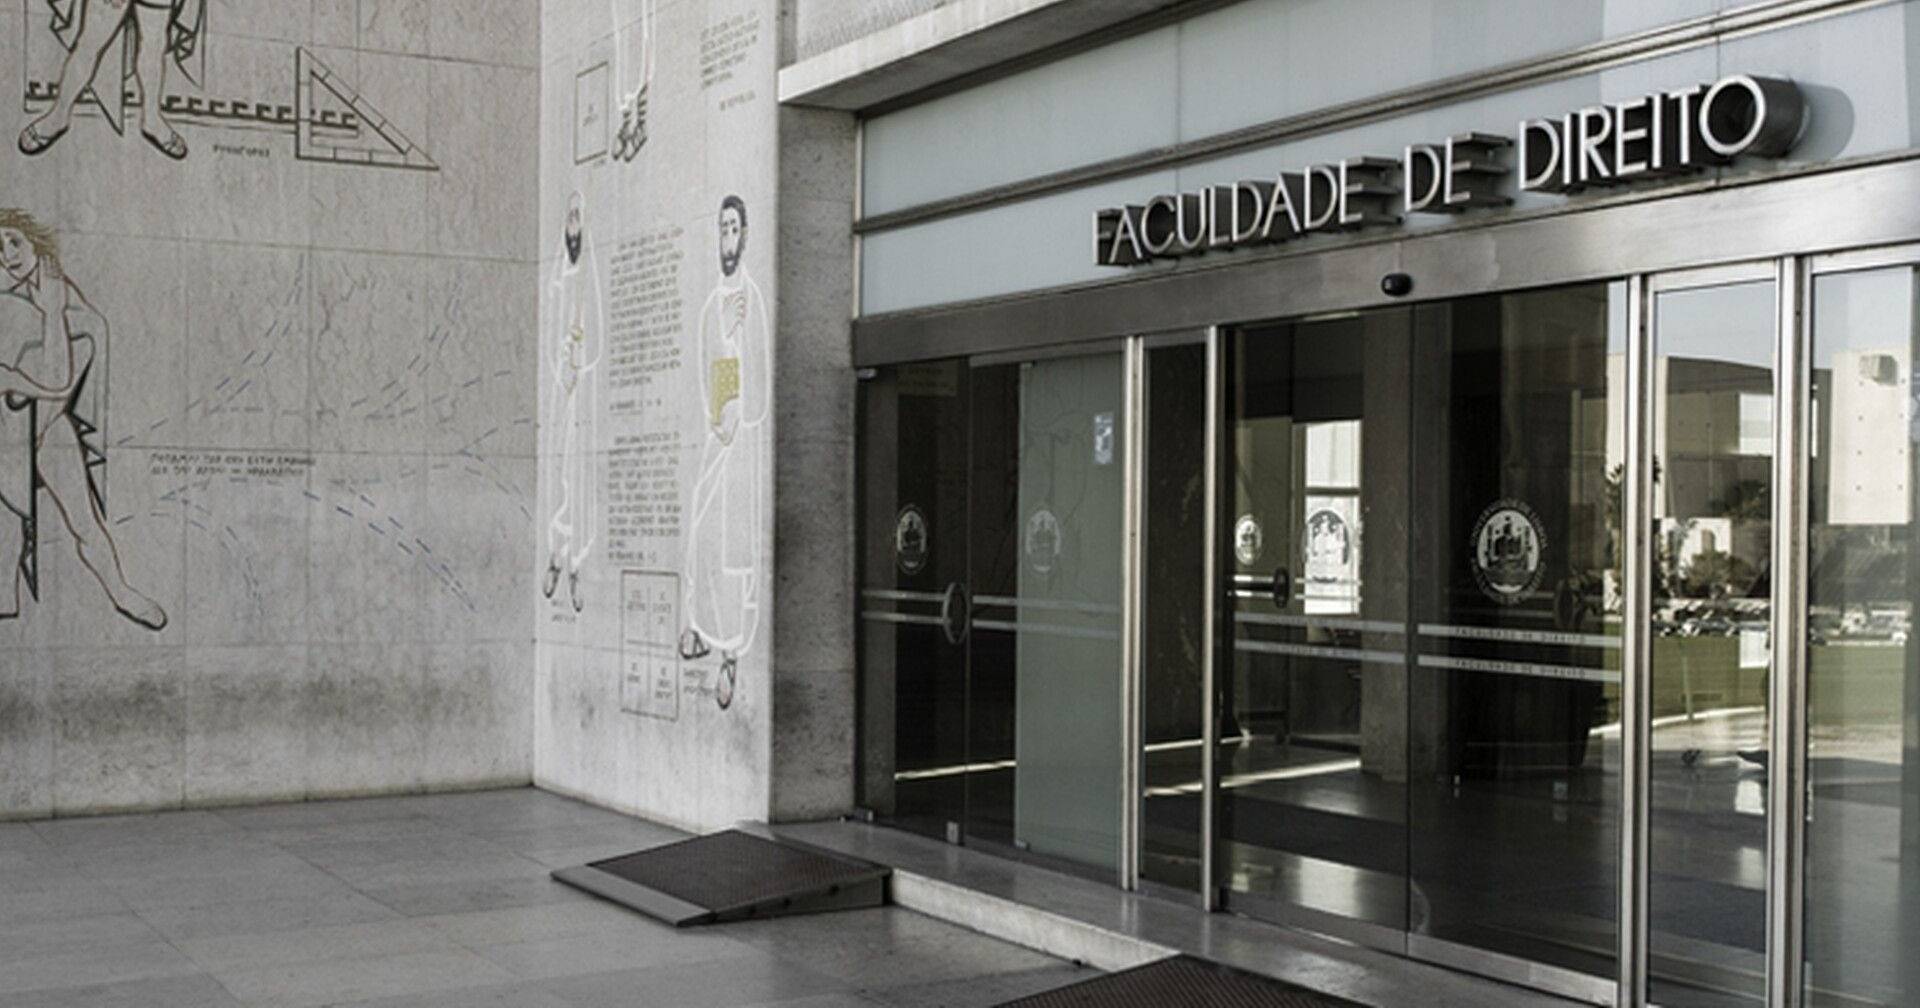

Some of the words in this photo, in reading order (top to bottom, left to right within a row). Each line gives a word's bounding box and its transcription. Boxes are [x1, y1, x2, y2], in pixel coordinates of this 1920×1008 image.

[1092, 158, 1364, 266] FACULDADE
[1404, 136, 1472, 212] DE
[1518, 74, 1766, 191] DIREITO
